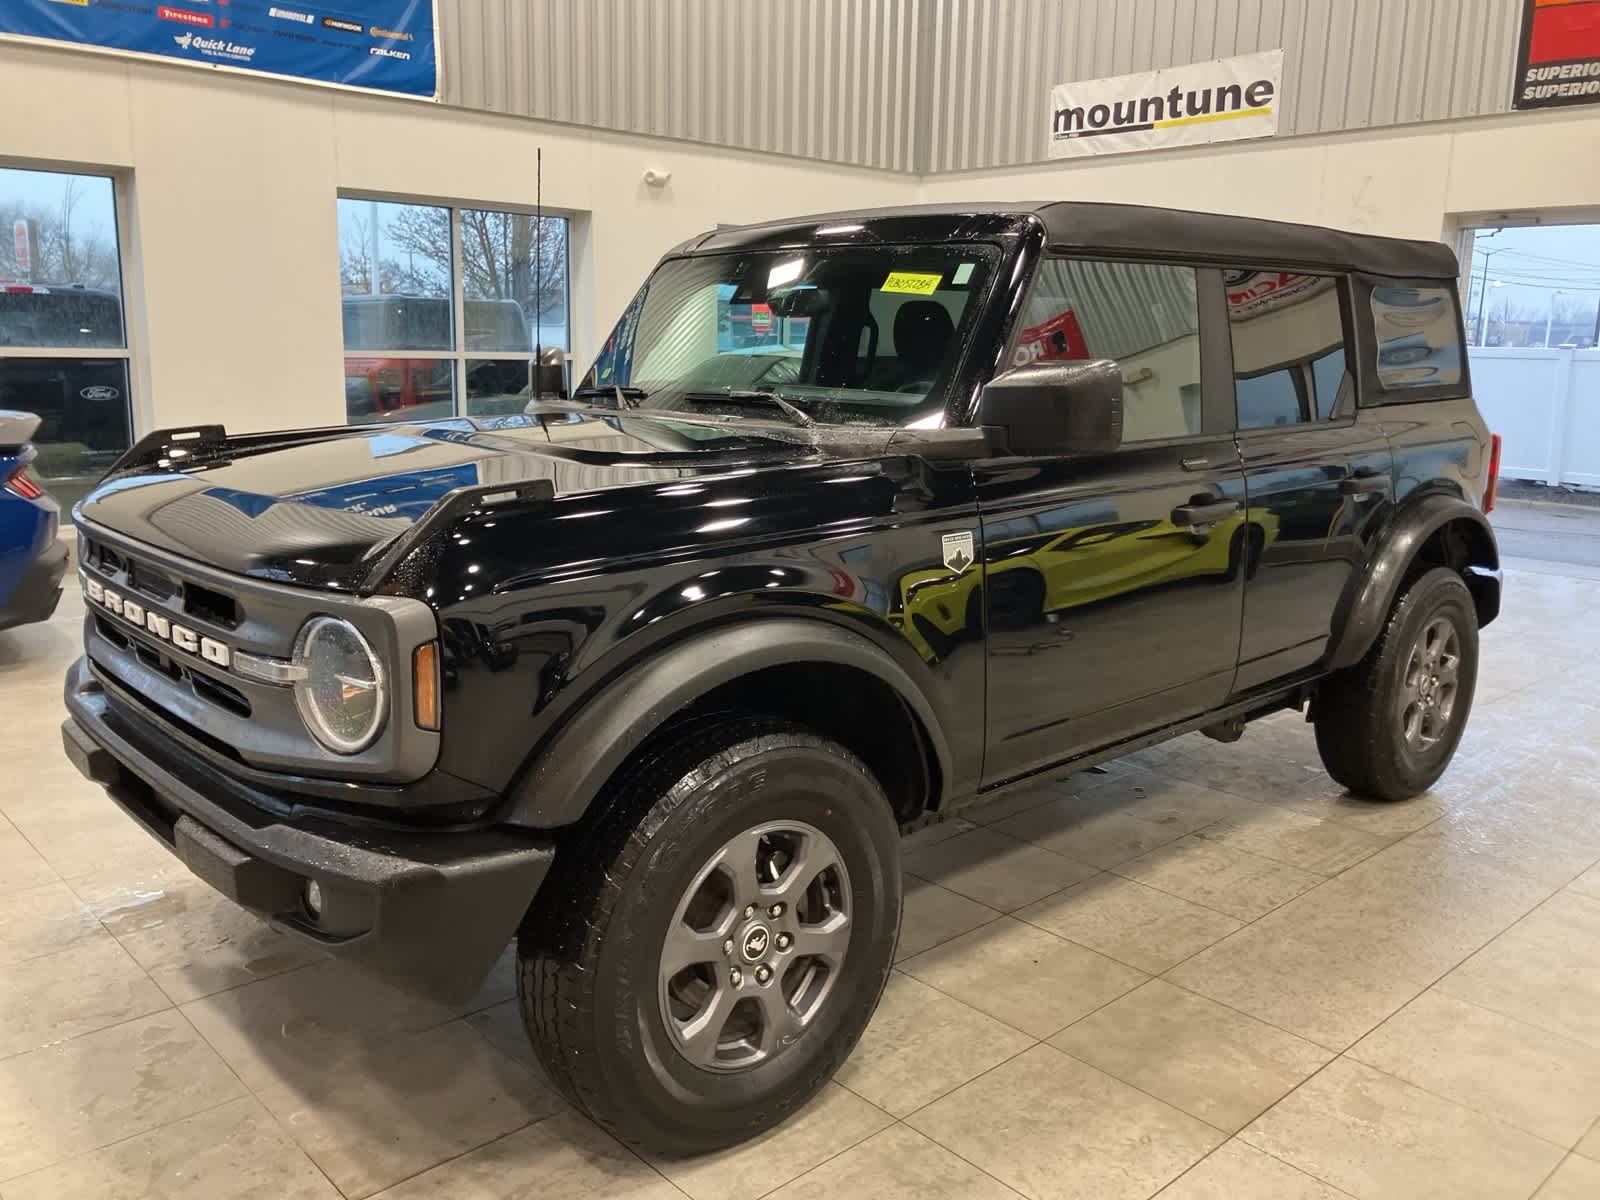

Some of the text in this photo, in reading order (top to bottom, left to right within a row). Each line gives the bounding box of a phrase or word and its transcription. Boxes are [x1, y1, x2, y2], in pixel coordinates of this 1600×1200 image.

[191, 36, 226, 51] Quick
[226, 41, 256, 56] Lane
[370, 47, 411, 60] FALKEN
[1522, 80, 1600, 100] SUPERIO
[1053, 79, 1275, 132] mountune
[85, 387, 115, 399] Ford
[86, 577, 230, 667] BRONCO
